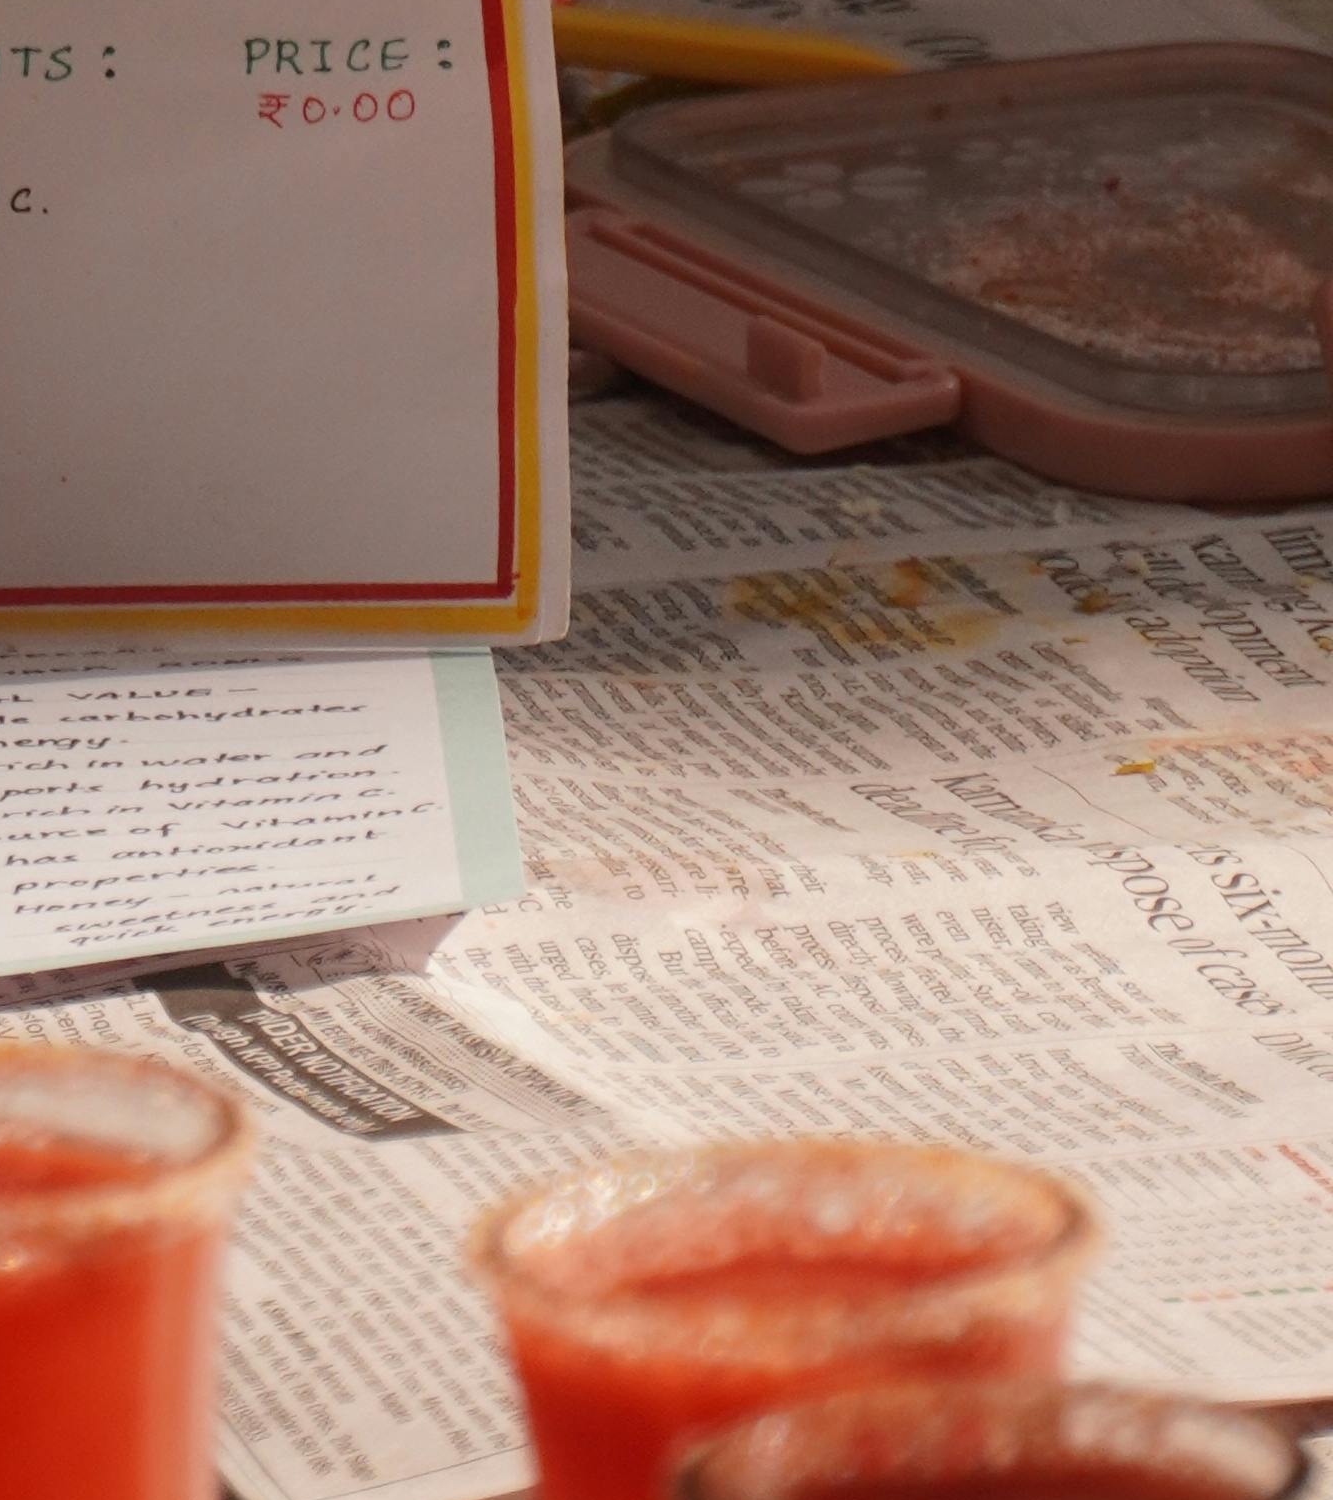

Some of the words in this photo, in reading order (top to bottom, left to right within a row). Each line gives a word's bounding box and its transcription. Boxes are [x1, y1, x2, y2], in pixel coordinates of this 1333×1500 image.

[258, 89, 415, 128] ₹0.00
[9, 187, 48, 214] C.
[68, 688, 214, 700] VALUE
[87, 758, 125, 768] in
[141, 753, 271, 768] water
[294, 743, 390, 761] and
[140, 768, 401, 794] hydration.
[2, 806, 90, 817] rich
[107, 806, 144, 815] in
[129, 822, 183, 838] of
[4, 854, 79, 865] has
[111, 830, 387, 861] antioxidant
[14, 897, 153, 915] Honey
[217, 875, 379, 896] natural
[54, 903, 275, 934] sweetness
[311, 886, 401, 904] and
[1045, 900, 1080, 935] view
[70, 925, 179, 947] quick
[936, 910, 971, 942] even
[1008, 904, 1051, 948] taking
[1168, 936, 1249, 963] of
